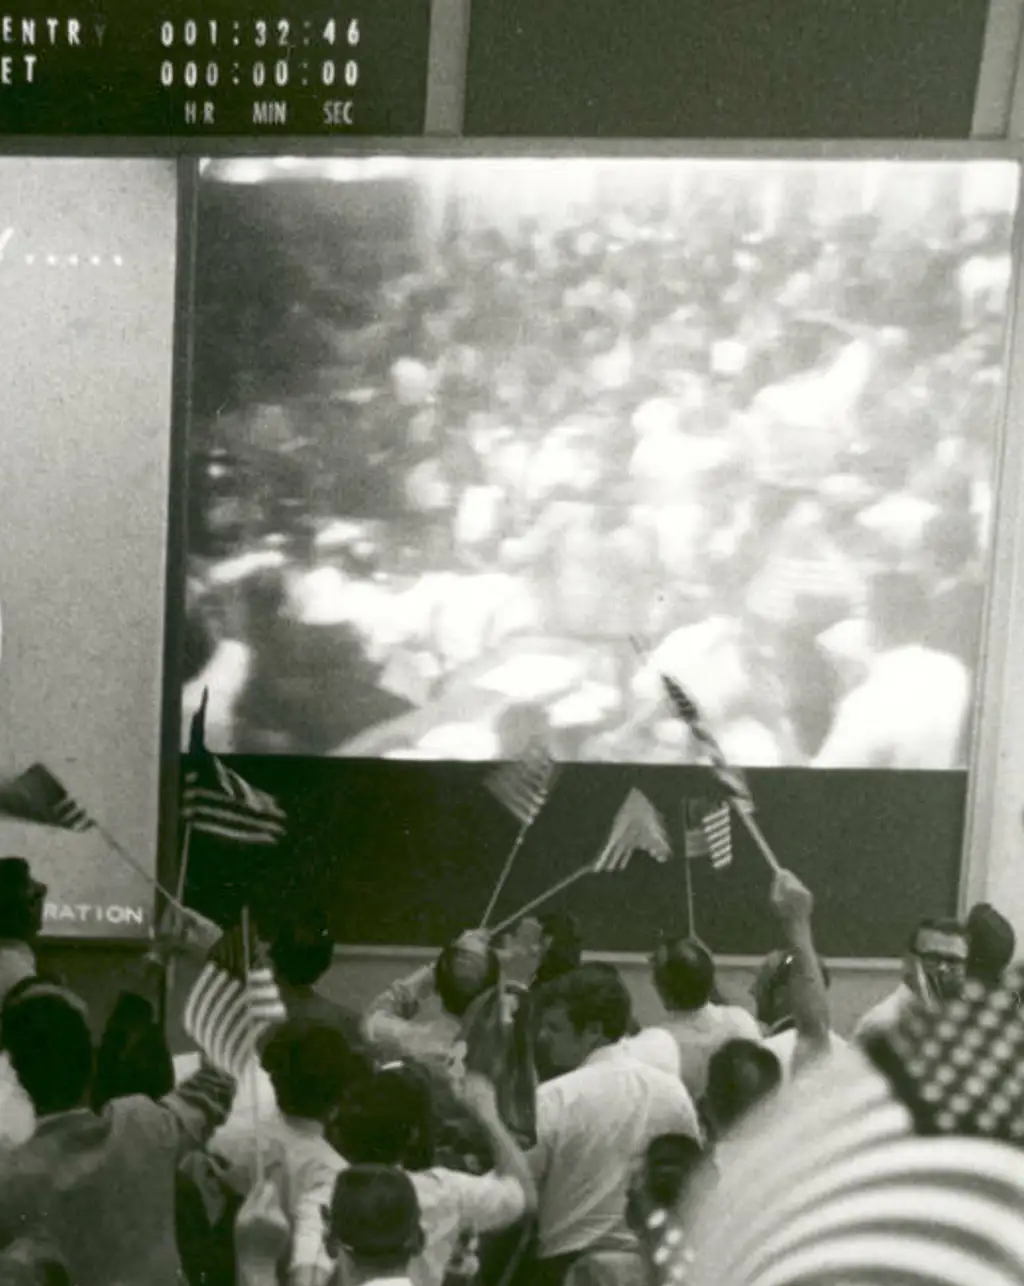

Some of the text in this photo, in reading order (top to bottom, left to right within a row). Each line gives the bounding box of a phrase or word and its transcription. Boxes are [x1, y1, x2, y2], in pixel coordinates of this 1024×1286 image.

[0, 54, 38, 86] ET
[185, 101, 355, 126] HR MIN SEC
